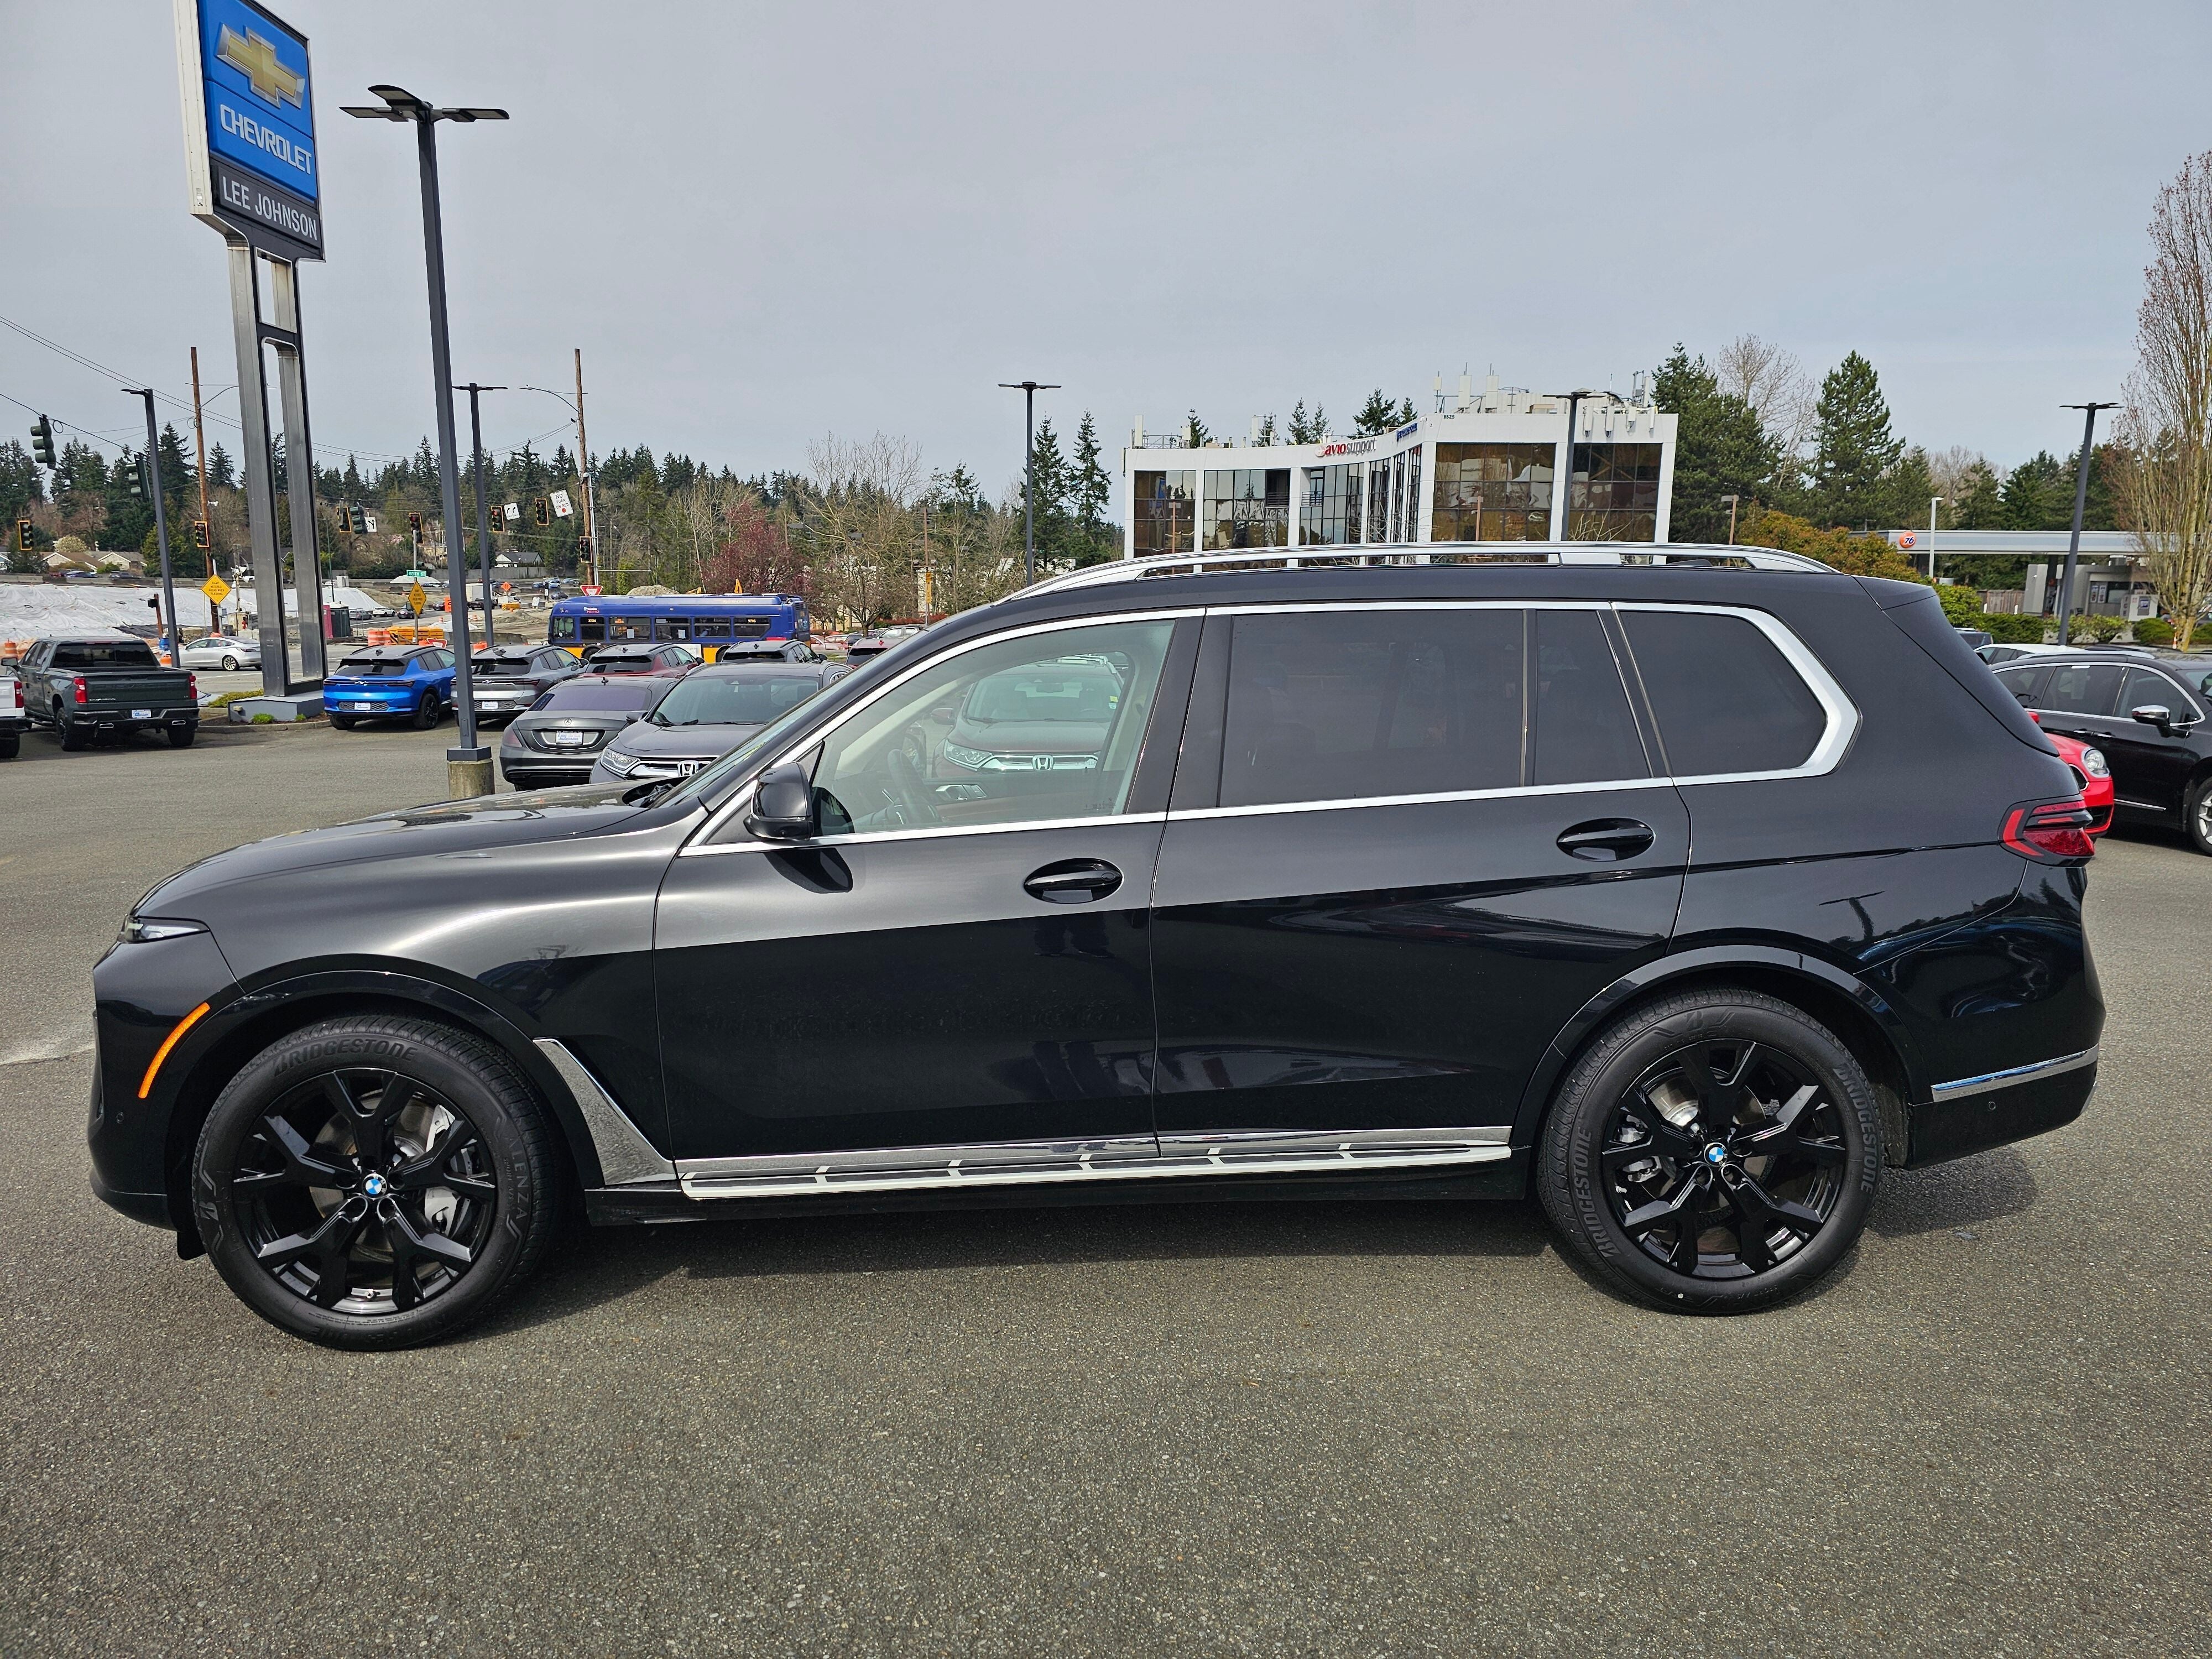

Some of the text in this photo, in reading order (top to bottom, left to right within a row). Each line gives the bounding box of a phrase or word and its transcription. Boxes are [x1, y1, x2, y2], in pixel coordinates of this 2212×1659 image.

[220, 104, 312, 174] CHEVROLET
[222, 176, 317, 240] LEE JOHNSON
[274, 1038, 419, 1077] BRIDGESTONE
[1832, 1062, 1877, 1194] BRIDGESTONE
[509, 1136, 529, 1219] ALENZA
[1573, 1126, 1621, 1258] BRIDGESTONE
